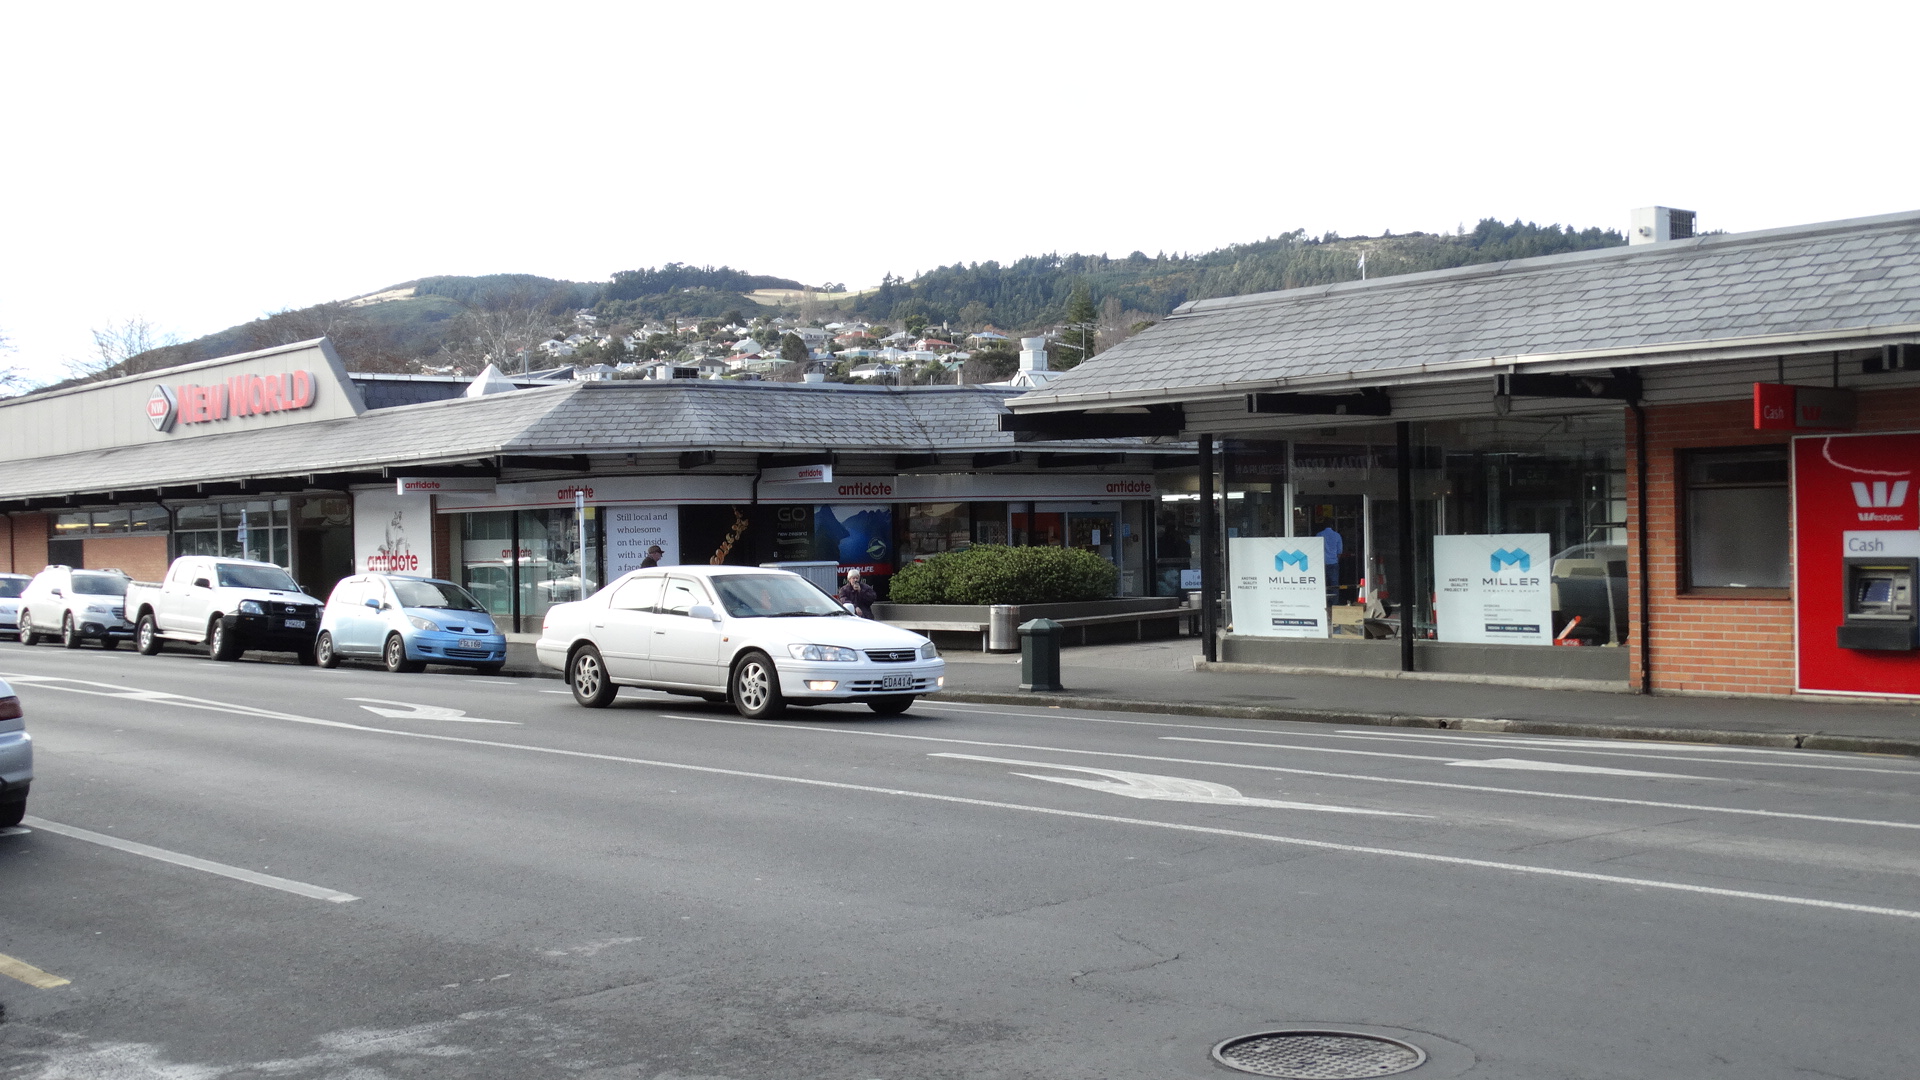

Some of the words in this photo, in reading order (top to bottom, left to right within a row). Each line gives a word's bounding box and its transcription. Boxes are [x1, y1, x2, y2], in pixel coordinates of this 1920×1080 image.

[177, 384, 227, 424] NEW
[227, 370, 313, 417] WORLD
[150, 400, 164, 415] NW
[1763, 405, 1784, 419] Cash
[798, 469, 823, 478] antidote
[405, 480, 440, 489] antidote
[838, 482, 892, 496] antidote
[1106, 480, 1151, 493] antidote
[557, 485, 593, 499] antidte
[633, 513, 651, 521] local
[777, 507, 806, 521] GO
[1857, 512, 1903, 522] Westpac
[629, 538, 641, 546] the
[1848, 538, 1884, 551] Cash
[367, 550, 418, 571] antidote
[1268, 576, 1316, 584] MILLER
[1482, 577, 1540, 586] MILLER
[883, 677, 911, 687] EDA414
